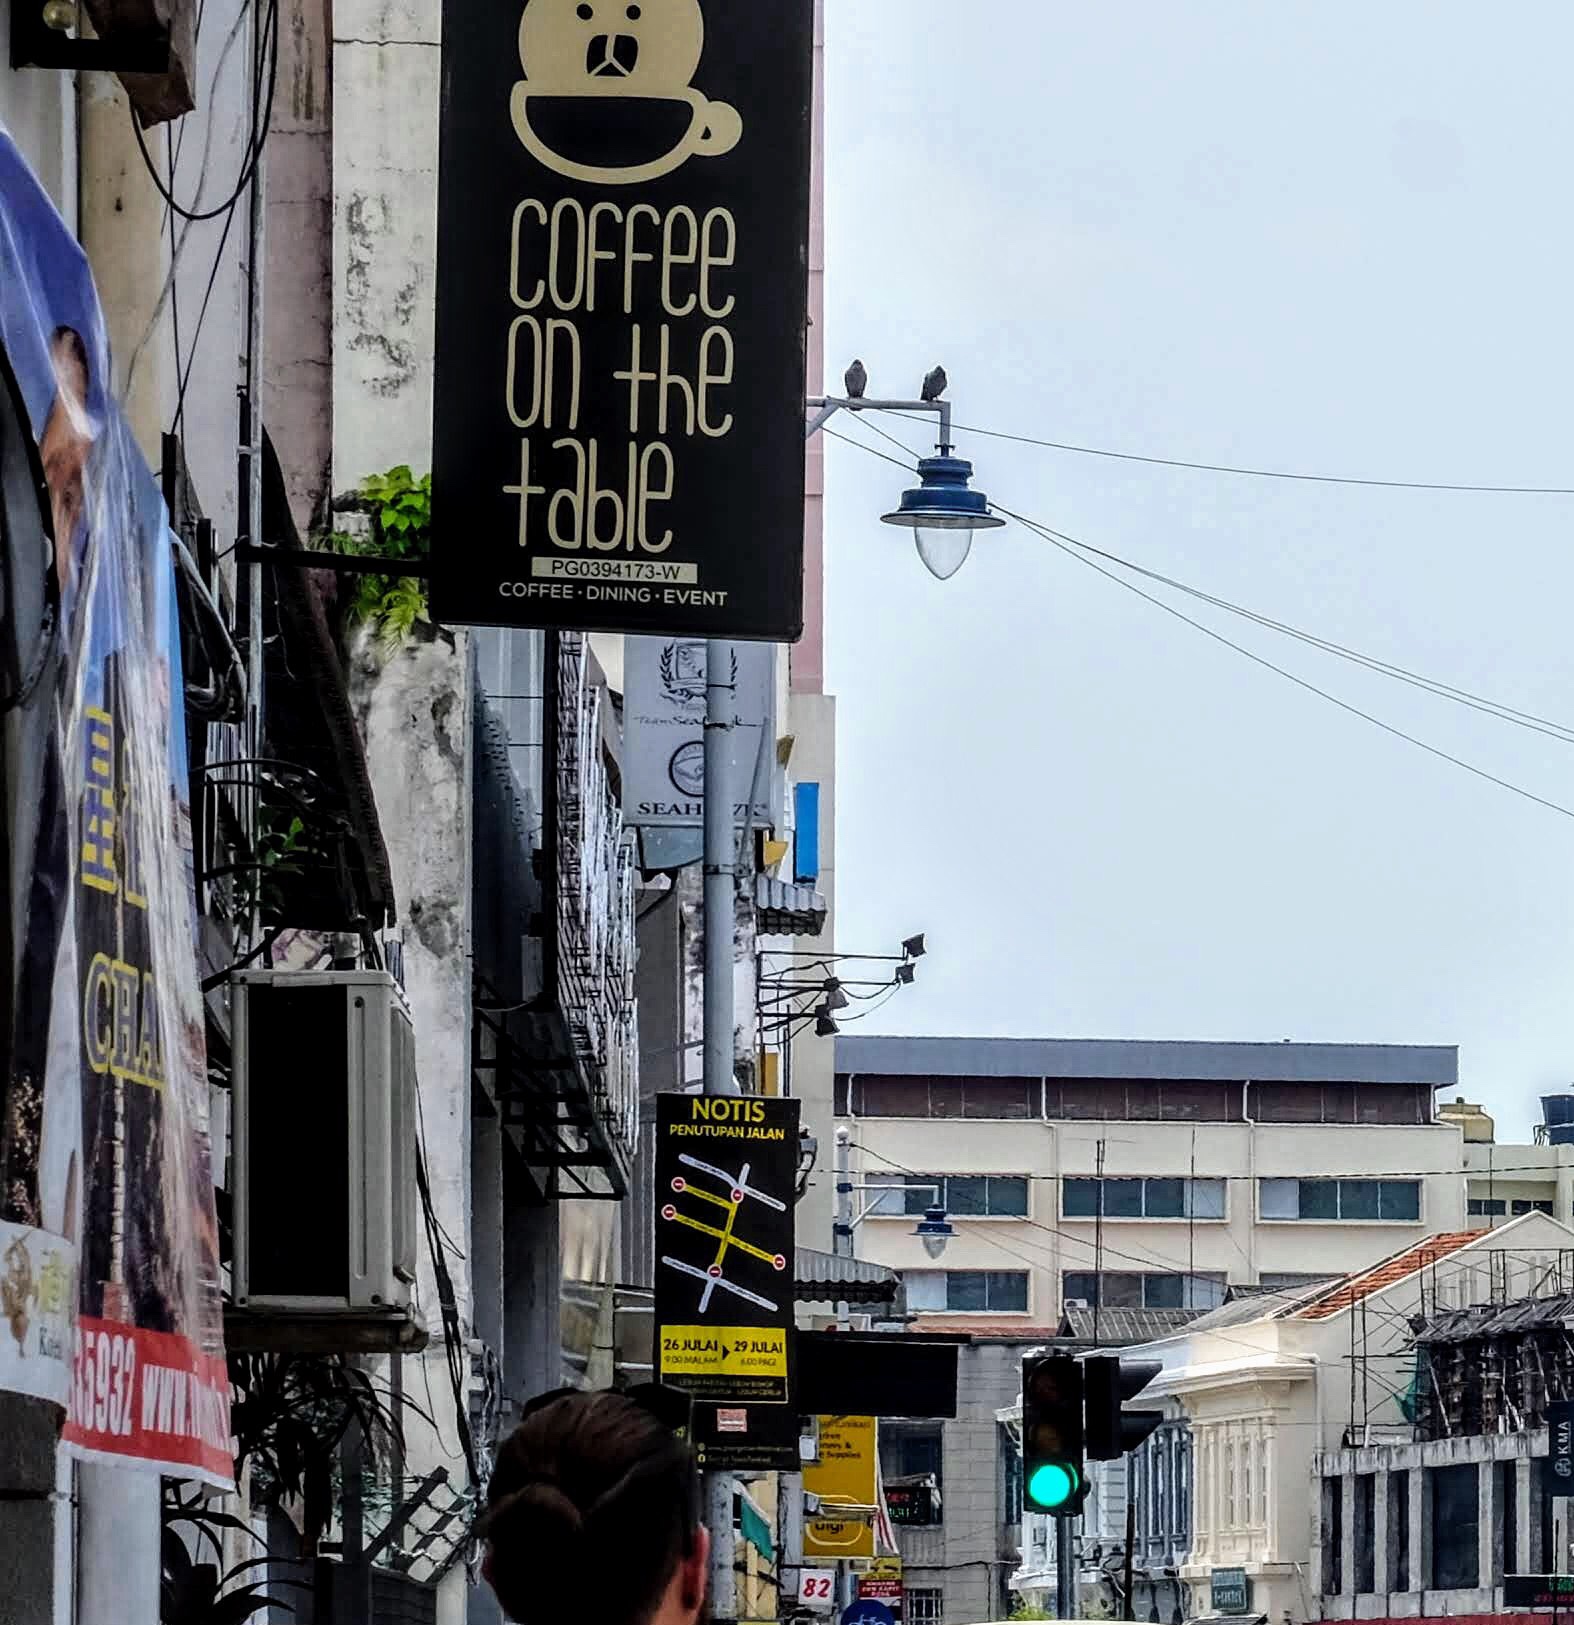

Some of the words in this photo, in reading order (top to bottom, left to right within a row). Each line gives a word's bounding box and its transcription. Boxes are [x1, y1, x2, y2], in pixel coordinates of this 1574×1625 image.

[551, 559, 681, 580] PG0394173-W
[499, 581, 574, 600] COFFEE
[587, 586, 652, 604] DINING
[663, 590, 728, 606] EVENT
[691, 1097, 766, 1123] NOTIS
[669, 1124, 745, 1139] PENUTUPAN
[746, 1126, 785, 1141] JALAN
[663, 1338, 679, 1351] 26
[682, 1338, 718, 1352] JULAI
[733, 1340, 748, 1353] 29
[750, 1341, 783, 1354] JULAI
[802, 1578, 833, 1598] 82
